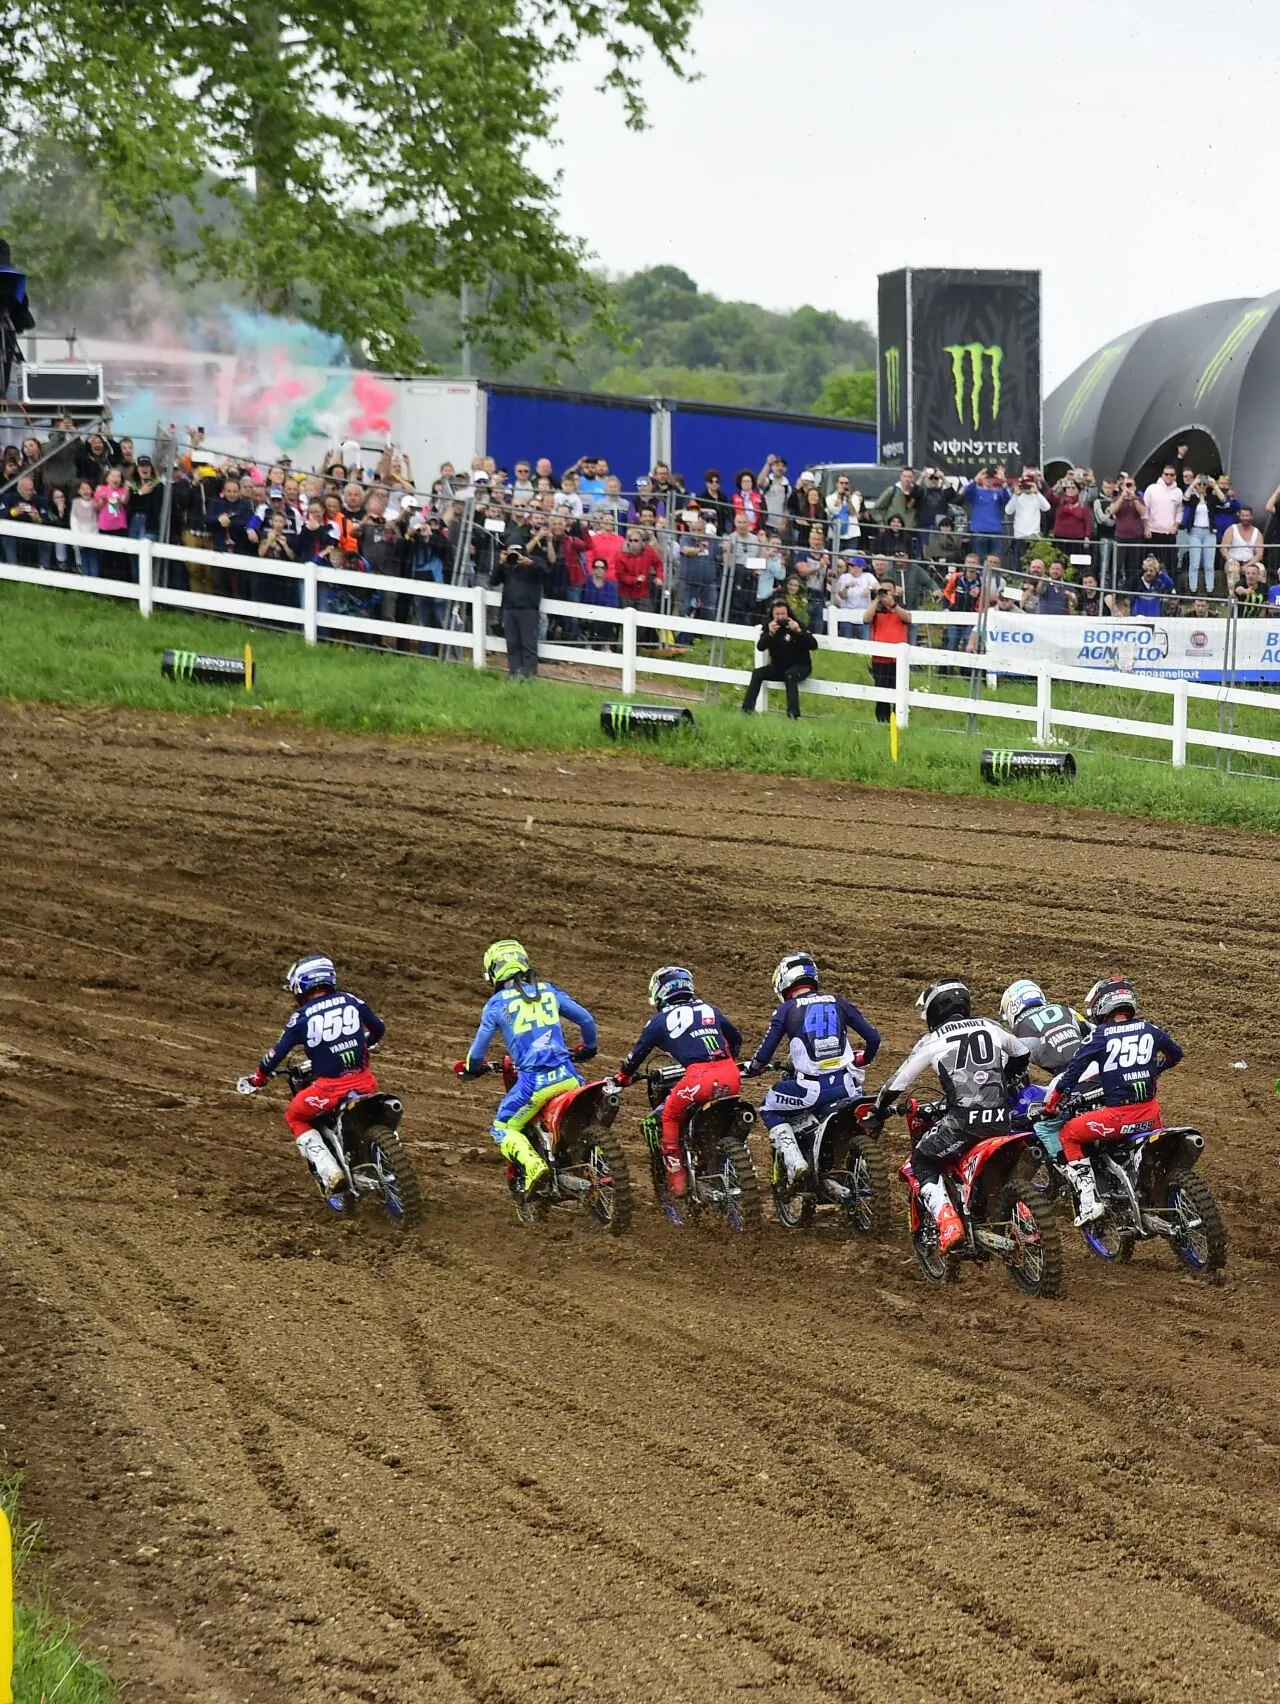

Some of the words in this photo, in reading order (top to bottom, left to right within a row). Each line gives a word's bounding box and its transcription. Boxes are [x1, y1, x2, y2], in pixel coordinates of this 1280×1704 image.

[933, 438, 1021, 456] MONSTER
[987, 631, 1034, 644] VECO
[508, 991, 560, 1035] 243
[665, 1003, 716, 1039] 91
[803, 1003, 838, 1038] 41
[1028, 1004, 1064, 1032] 10
[306, 1005, 360, 1047] 959
[689, 1028, 719, 1038] YAMAHA
[935, 1019, 986, 1038] FERNANDEZ
[328, 1039, 359, 1054] YAMAHA
[945, 1029, 995, 1070] 70
[1103, 1033, 1155, 1073] 259
[535, 1065, 568, 1085] FOX
[1122, 1069, 1151, 1082] YAMAHA
[775, 1094, 804, 1107] THOR
[968, 1107, 1006, 1125] FOX
